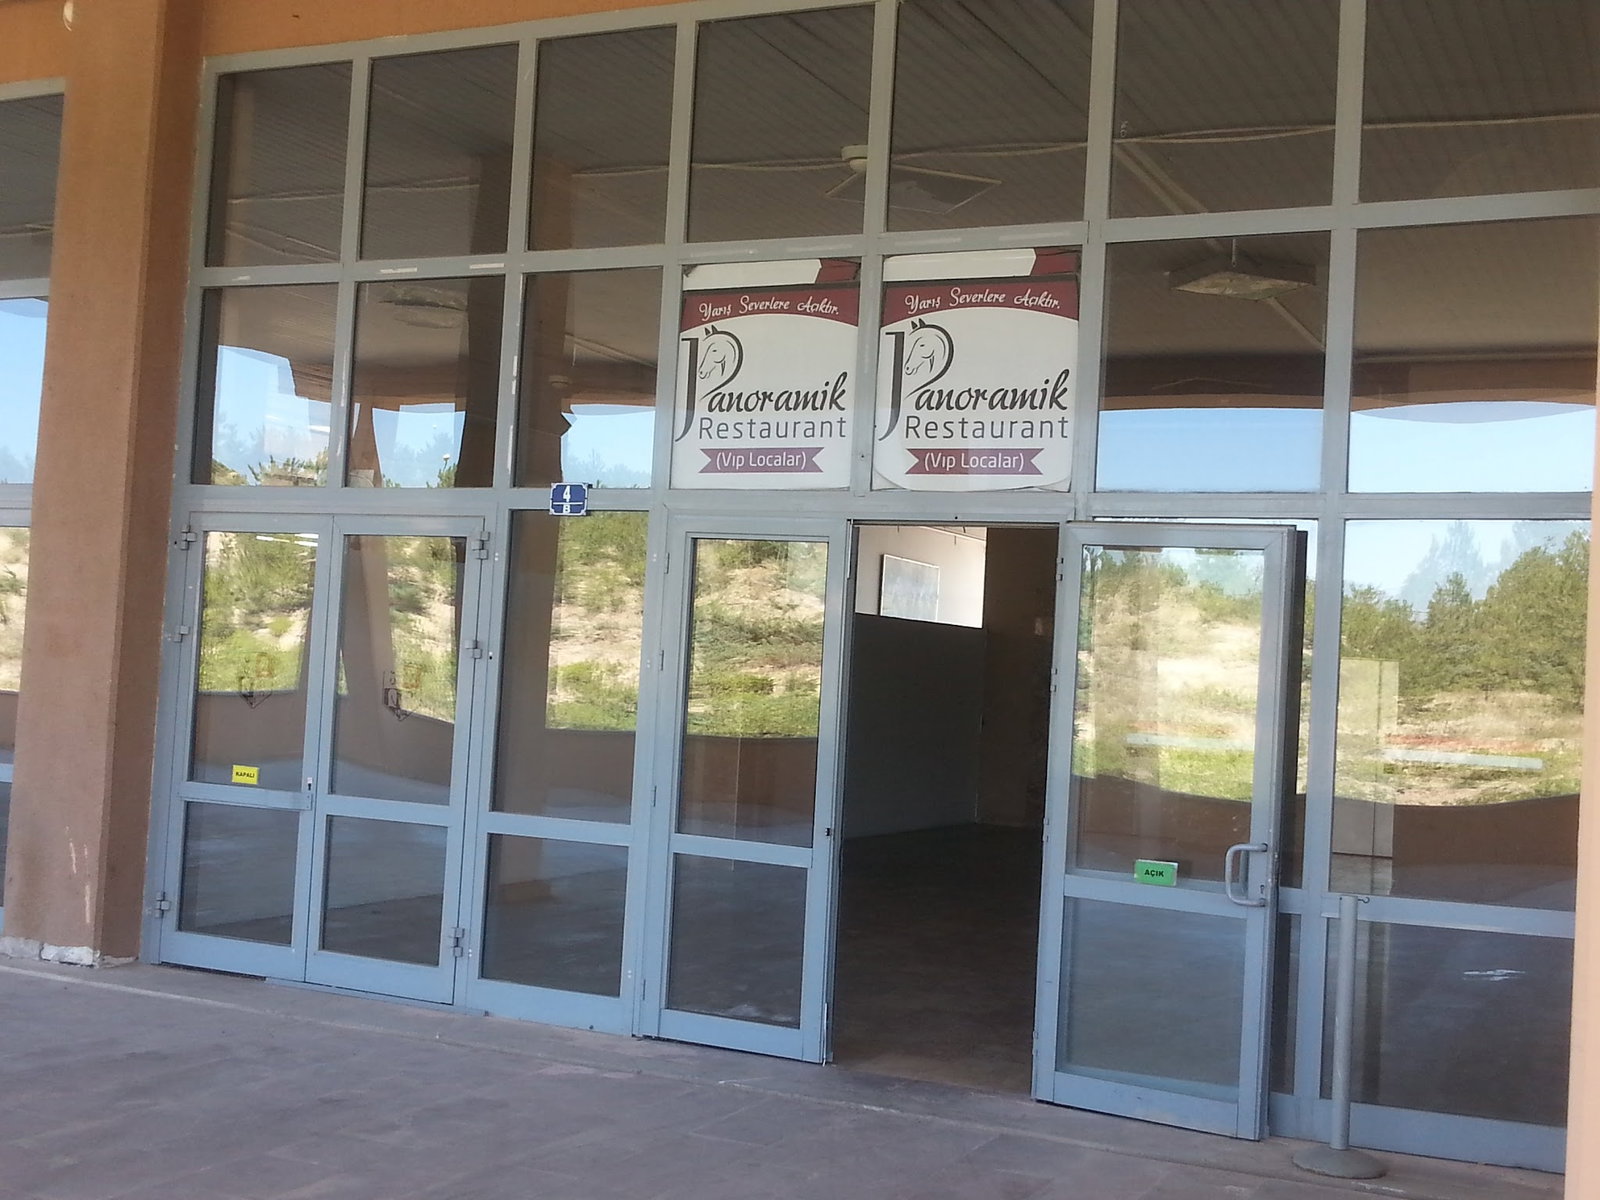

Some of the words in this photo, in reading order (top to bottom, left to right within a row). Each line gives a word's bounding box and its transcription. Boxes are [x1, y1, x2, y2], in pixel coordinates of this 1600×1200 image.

[699, 302, 732, 321] Yarış
[739, 295, 790, 315] Severlere
[905, 295, 940, 314] Yarış
[949, 287, 1006, 307] Severlere
[675, 325, 848, 442] Panoramik
[878, 319, 1070, 441] Panoramik
[699, 417, 847, 440] Restaurant
[905, 415, 1069, 439] Restaurant
[749, 451, 807, 470] Localar)
[961, 452, 1025, 472] Localar)
[563, 485, 571, 502] 4
[1144, 869, 1164, 877] AÇIK
